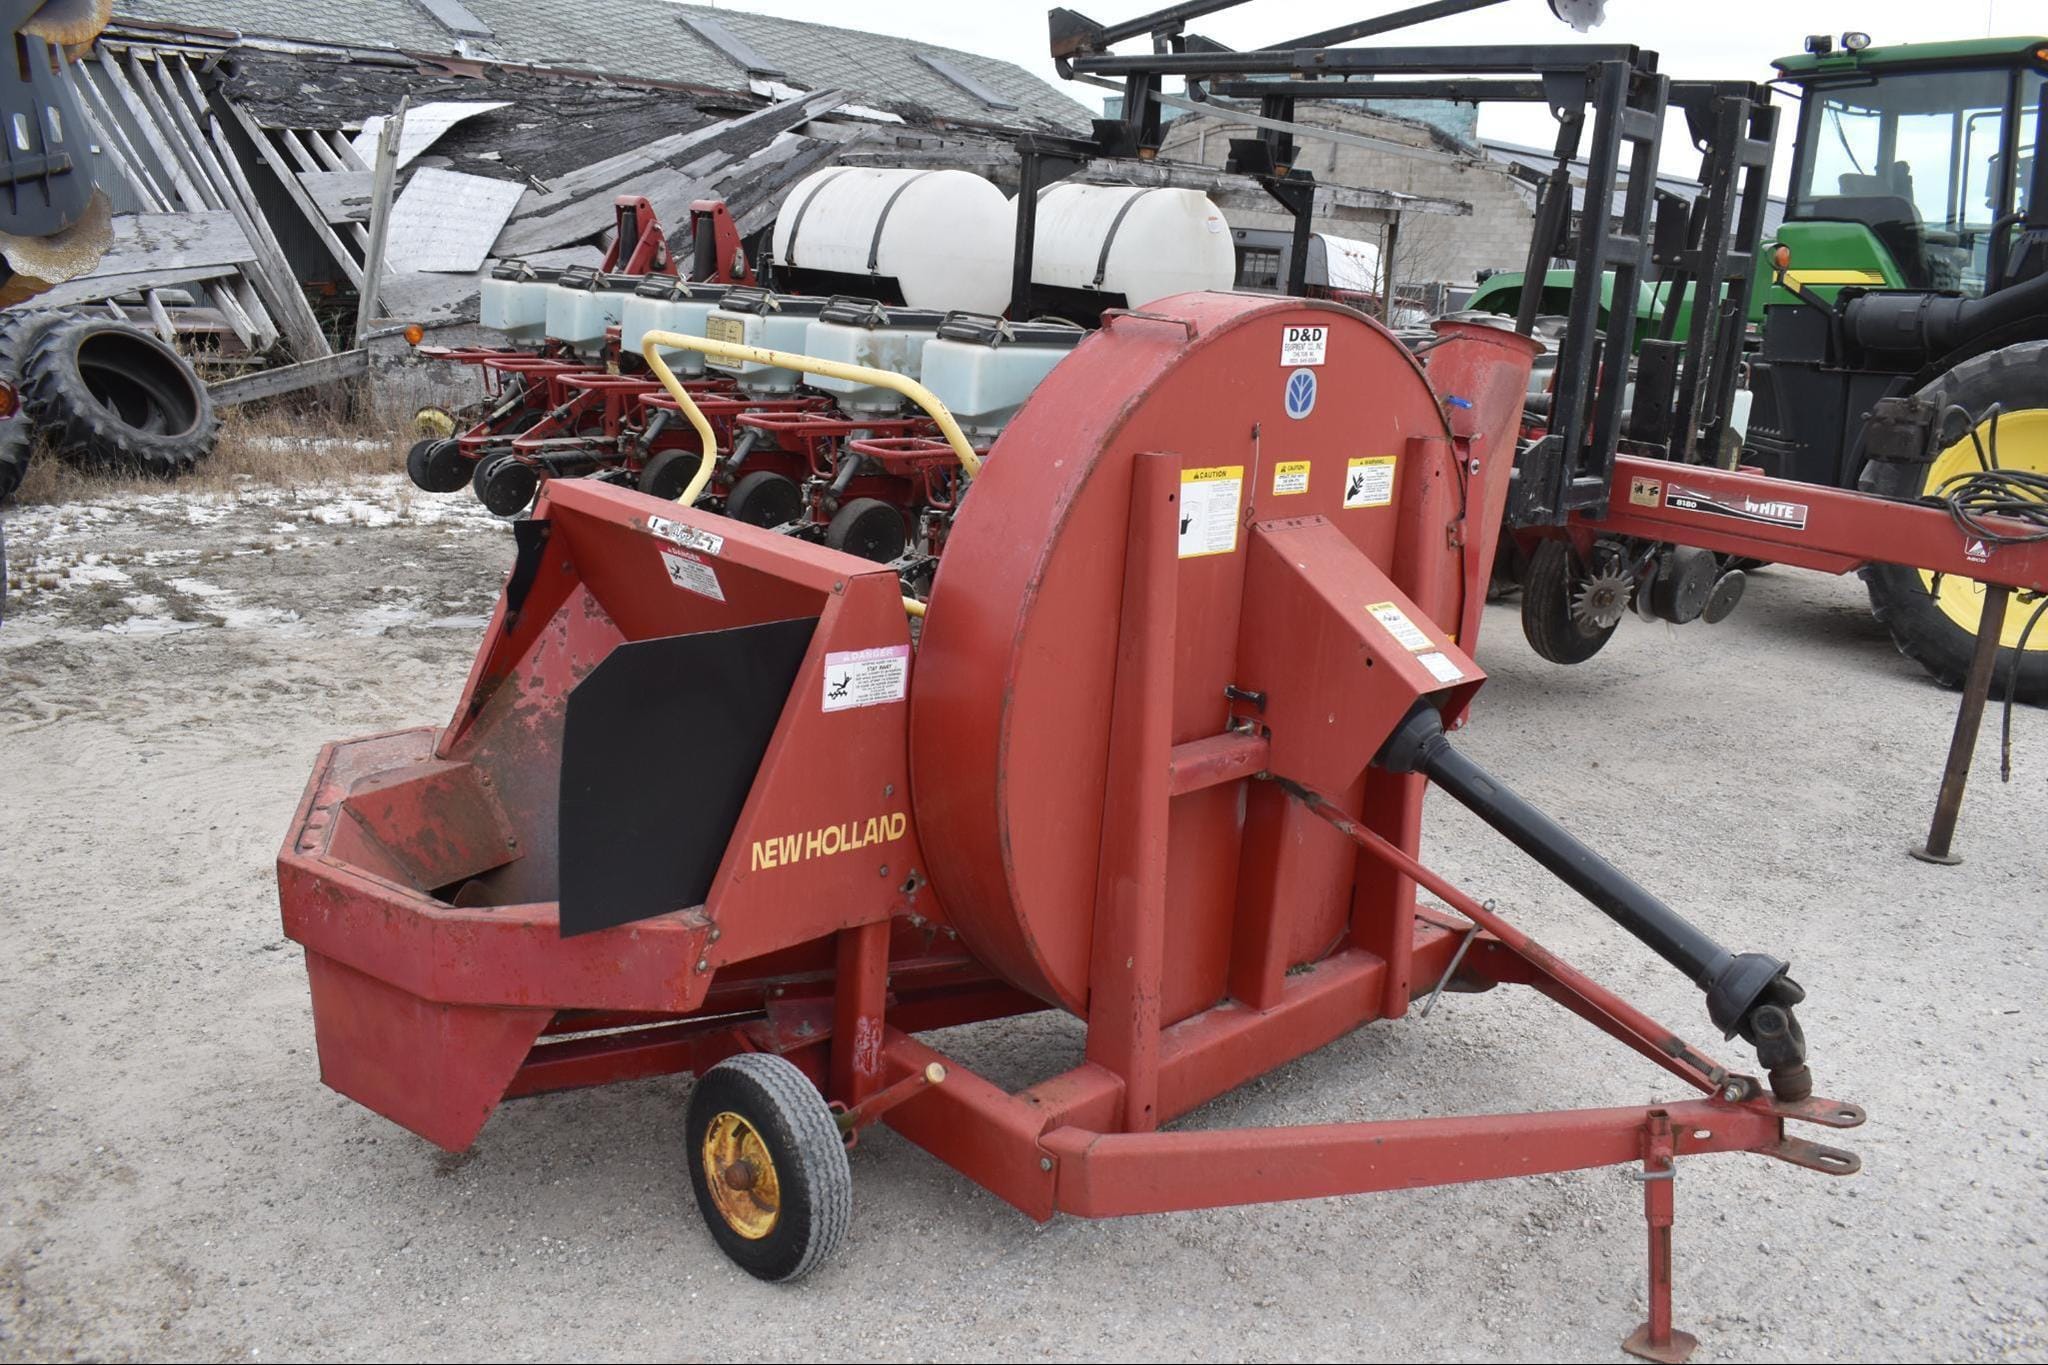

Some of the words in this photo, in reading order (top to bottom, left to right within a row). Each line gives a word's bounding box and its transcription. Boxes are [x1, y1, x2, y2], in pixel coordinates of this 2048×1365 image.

[1289, 328, 1322, 342] D&D
[1200, 470, 1227, 479] CAUTION
[1287, 463, 1305, 472] CAUTION
[1676, 499, 1697, 509] 8180
[1745, 494, 1795, 519] WHITE
[672, 547, 701, 563] DANGER
[751, 832, 803, 871] NEW
[805, 812, 906, 860] HOLLAND
